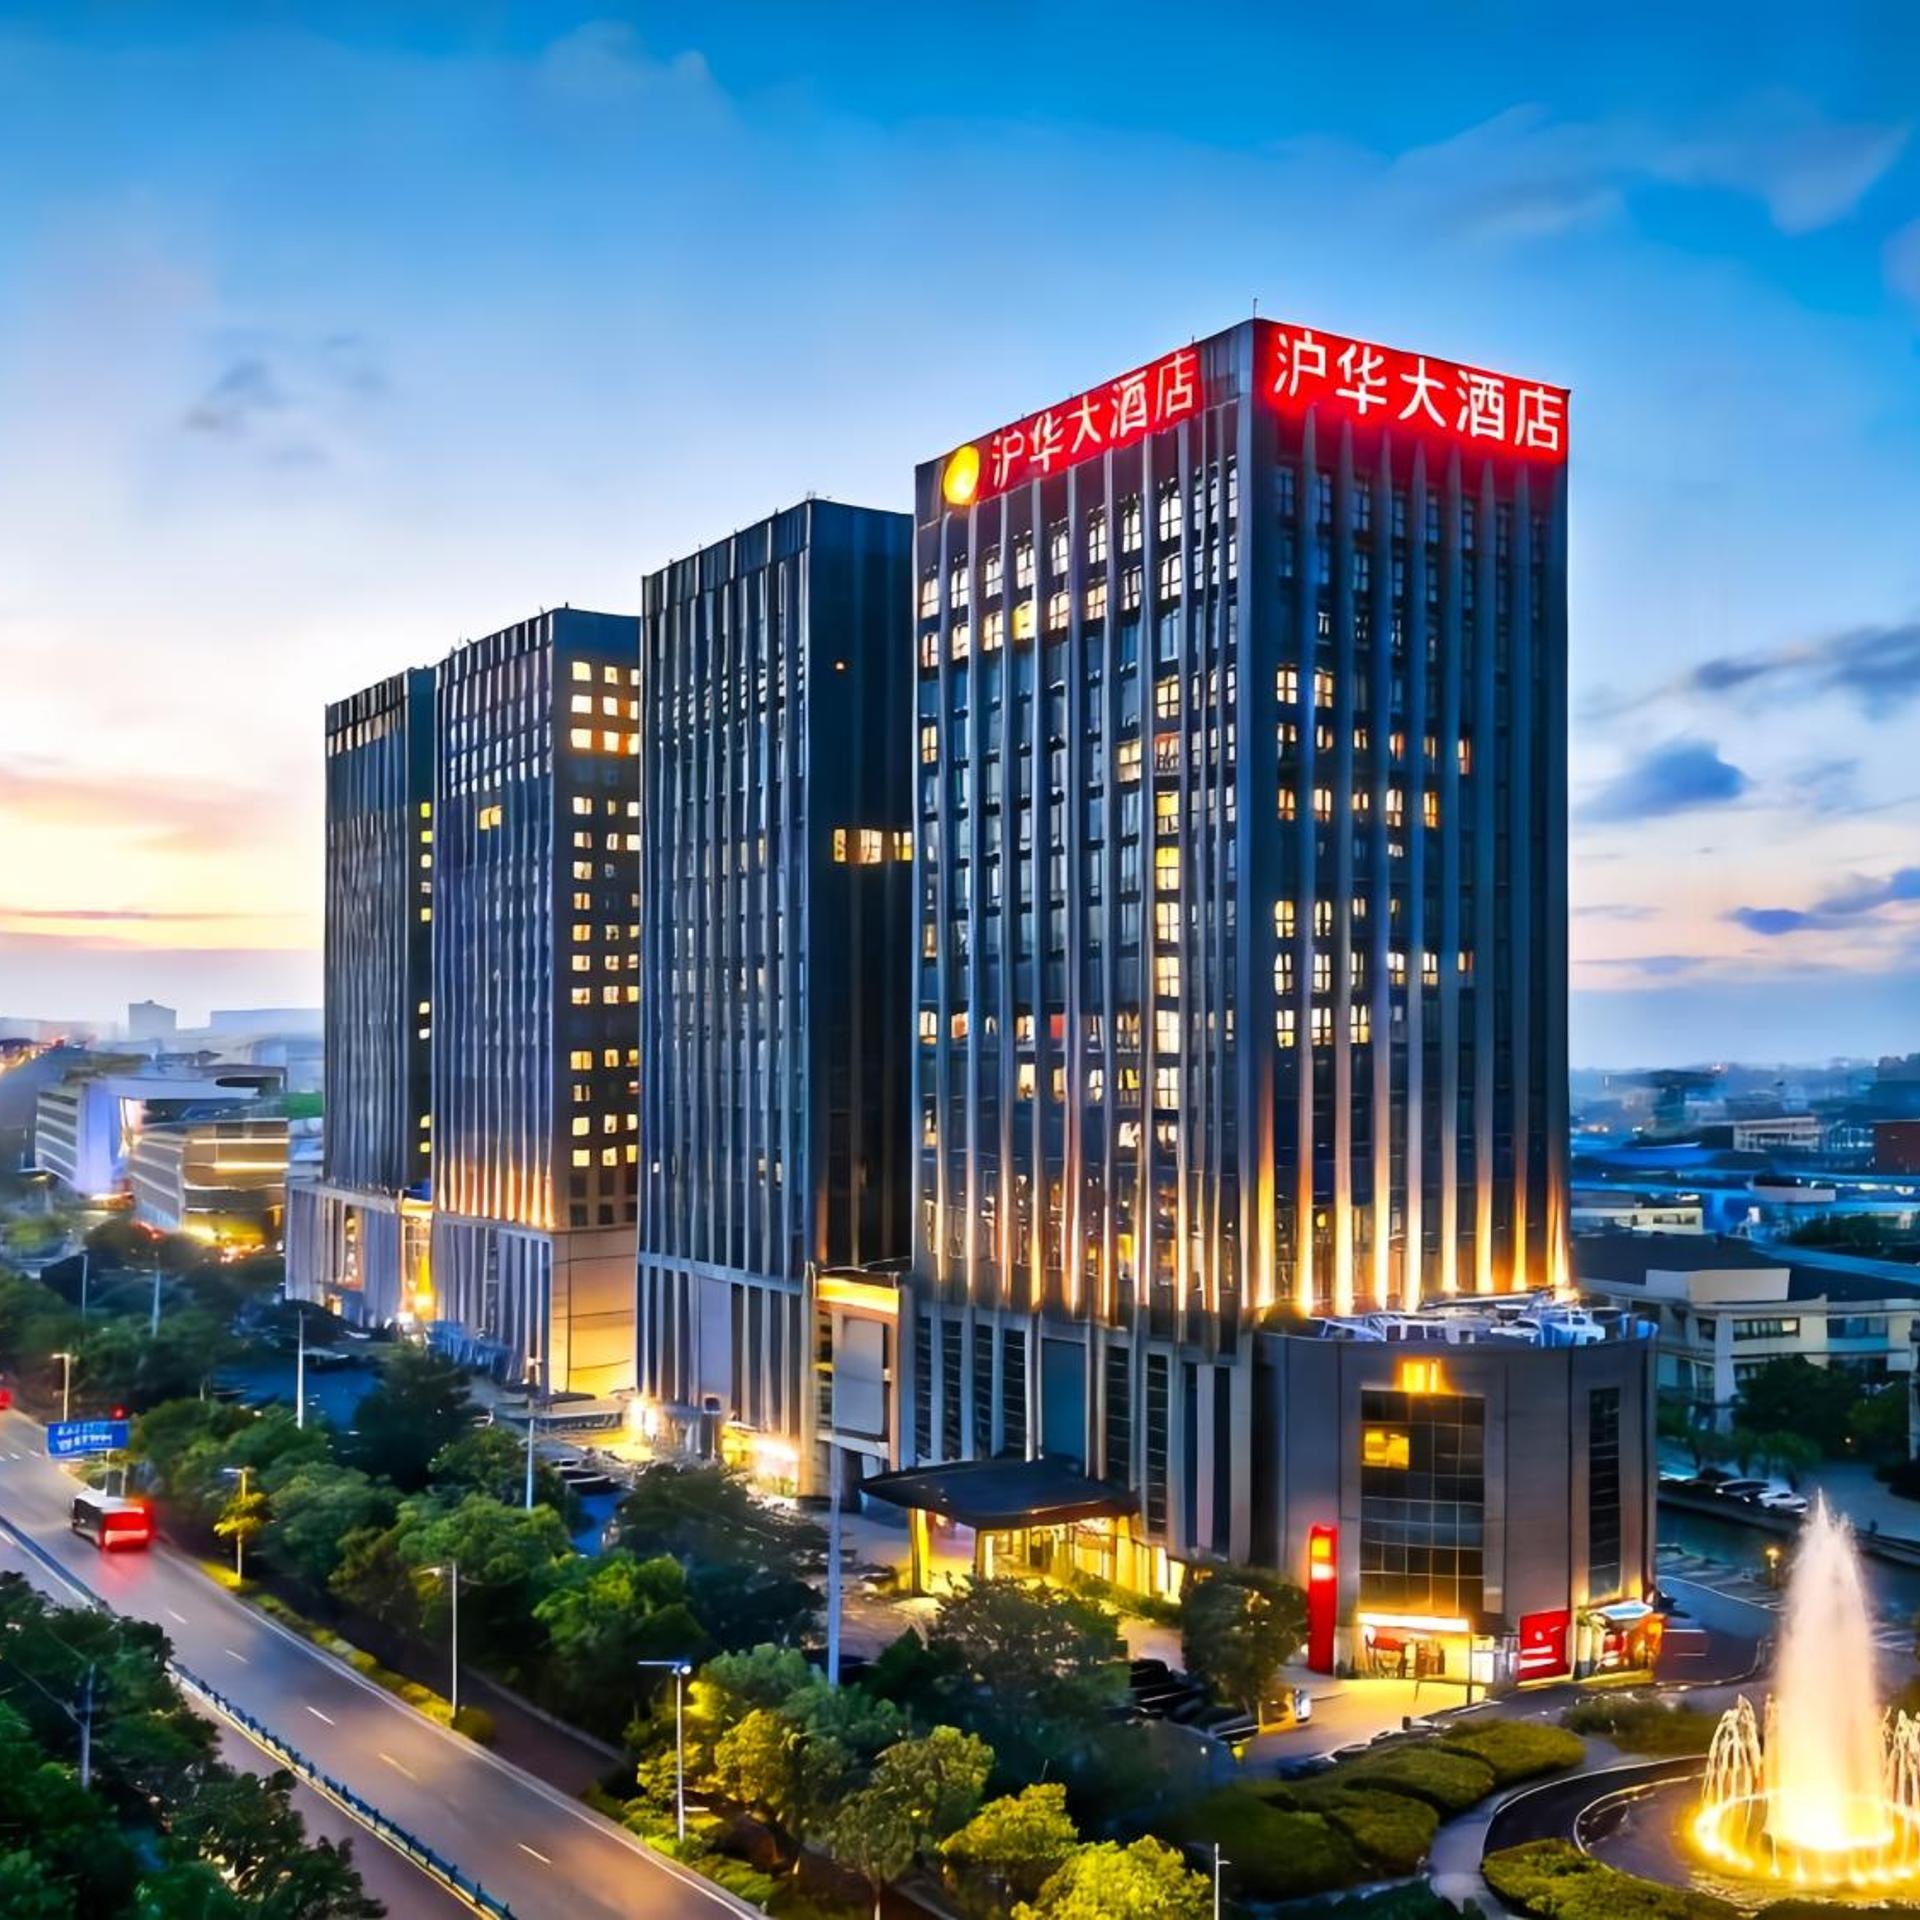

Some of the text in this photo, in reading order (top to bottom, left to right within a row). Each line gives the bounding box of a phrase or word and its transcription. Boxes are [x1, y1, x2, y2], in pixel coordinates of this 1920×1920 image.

[992, 352, 1195, 488] 沪华大酒店
[1274, 332, 1562, 451] 沪华大酒店
